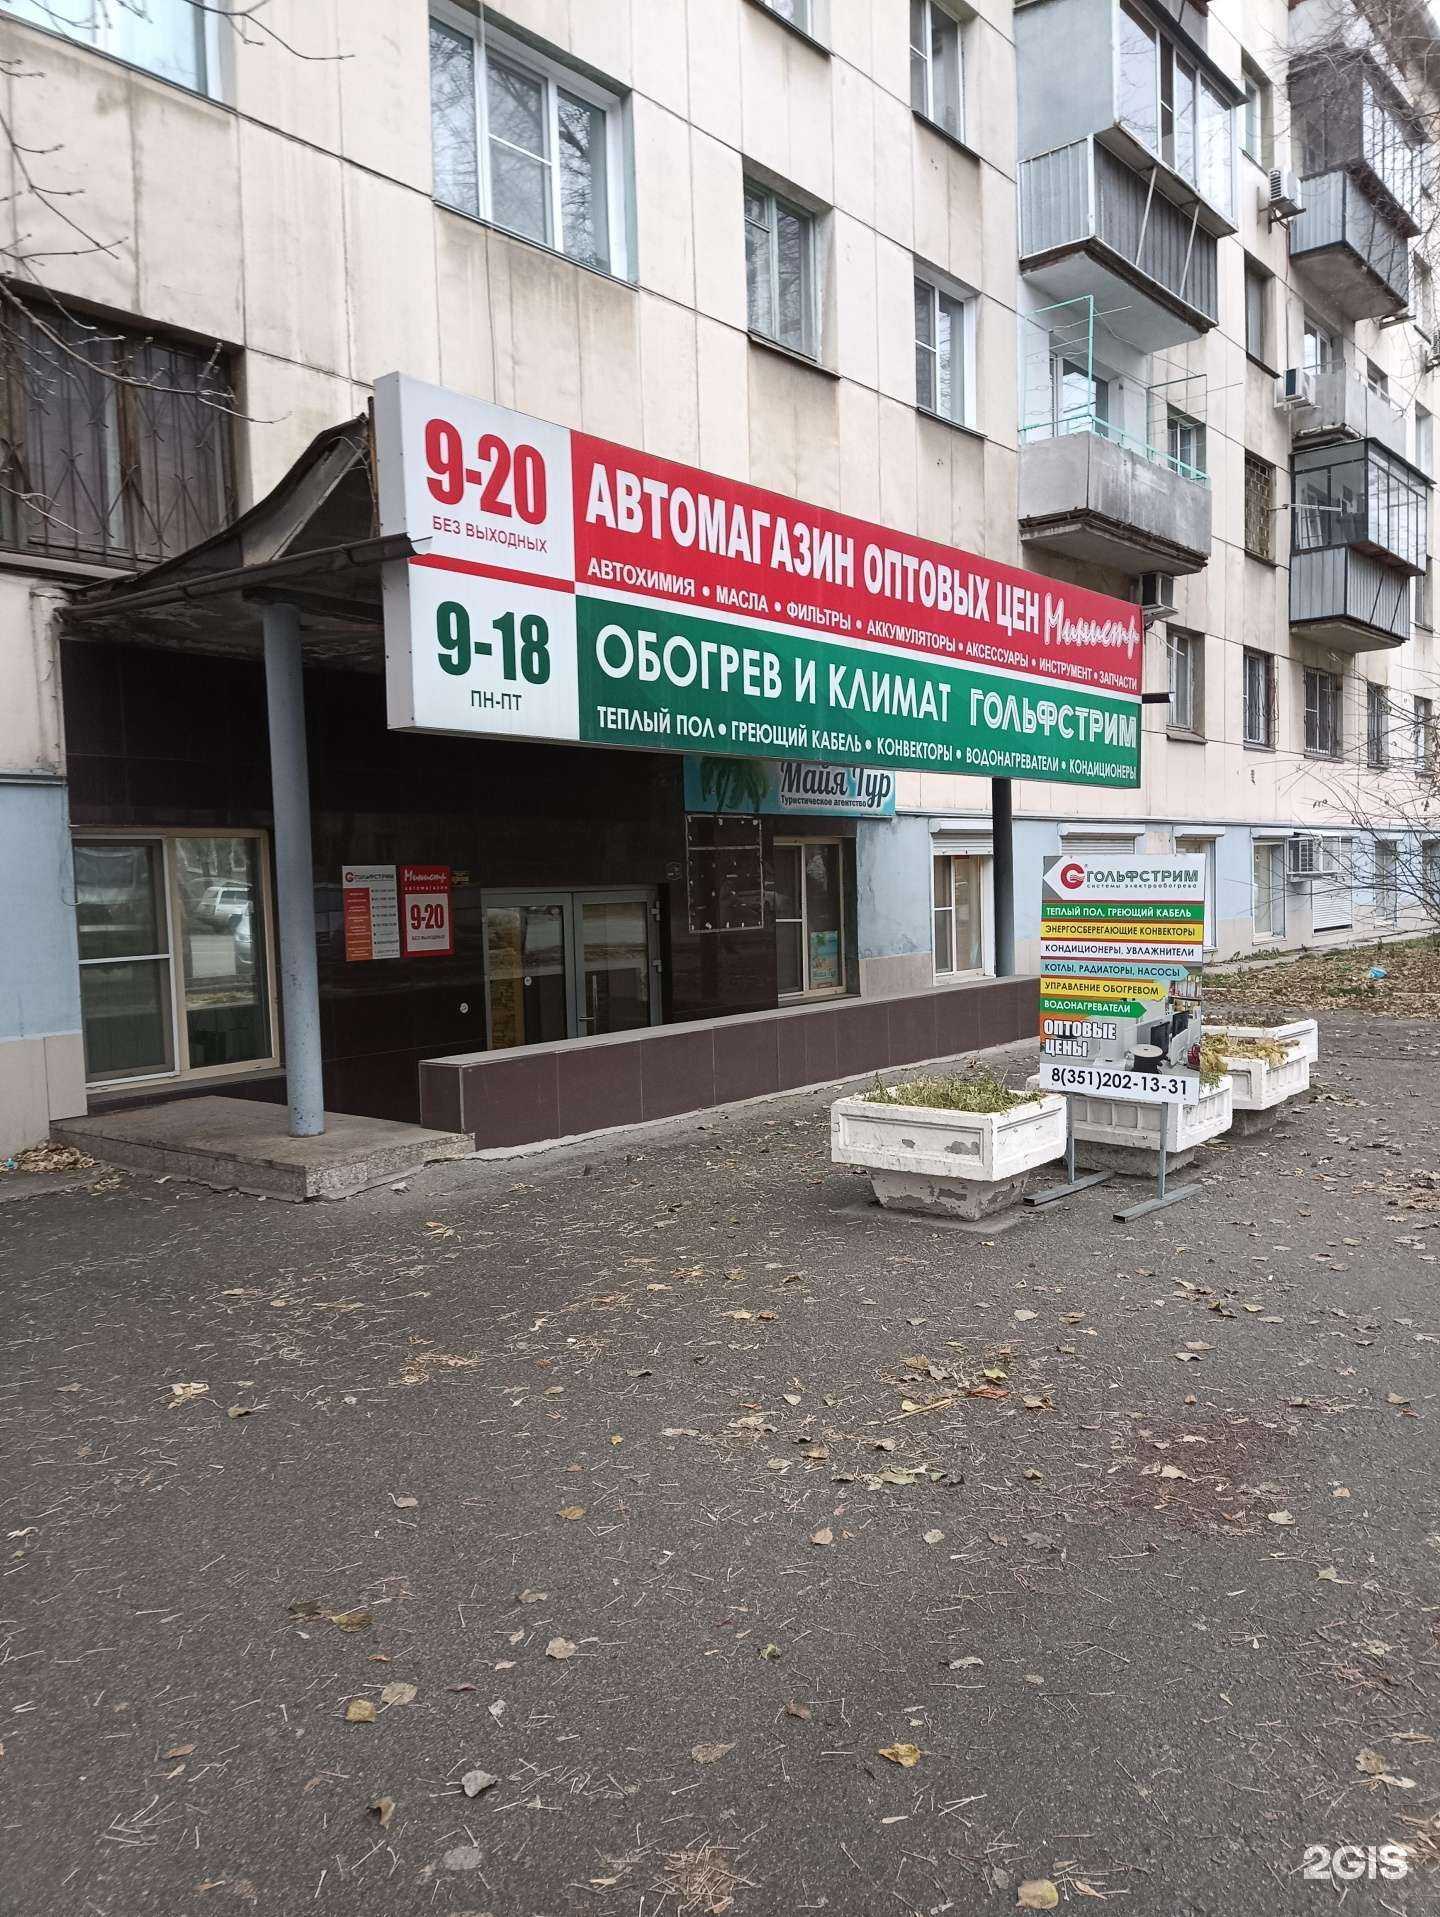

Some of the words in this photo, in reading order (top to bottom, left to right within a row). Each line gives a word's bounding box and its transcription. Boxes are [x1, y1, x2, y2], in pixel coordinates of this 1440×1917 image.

[425, 418, 547, 525] 9-20
[432, 515, 461, 535] БЕЗ
[466, 524, 548, 553] ВЫХОДНЫХ
[585, 463, 854, 587] АВТОМАГАЗИН
[863, 543, 990, 623] ОПТОВЫХ
[996, 581, 1039, 636] ЦЕН
[1044, 592, 1140, 660] Министр
[587, 557, 695, 597] АВТОХИМИЯ
[716, 585, 768, 612] МАСЛА
[787, 600, 852, 630] ФИЛЬТРЫ
[867, 619, 956, 653] АККУМУЛЯТОРЫ
[965, 643, 1029, 668] АКСЕССУАРЫ
[1040, 656, 1092, 680] ИНСТРУМЕНТ
[1099, 670, 1137, 690] ЗАПЧАСТИ
[436, 600, 551, 685] 9-18
[596, 624, 782, 699] ОБОГРЕВ
[795, 657, 816, 704] И
[829, 664, 951, 722] КЛИМАТ
[970, 688, 1137, 749] ГОЛЬФСТРИМ
[471, 690, 522, 711] ПН-ПТ
[597, 705, 671, 734] ТЕПЛЫЙ
[677, 715, 715, 738] ПОЛ
[731, 720, 807, 748] ГРЕЮЩИЙ
[812, 730, 862, 752] КАБЕЛЬ
[877, 737, 953, 761] КОНВЕКТОРЫ
[966, 747, 1059, 772] ВОДОНАГРЕВАТЕЛИ
[1069, 758, 1137, 781] КОНДИЦИОНЕРЫ
[781, 761, 848, 796] Майя
[852, 767, 891, 808] Тур
[781, 795, 832, 807] Туристическое
[1086, 870, 1198, 882] ГОЛЬФСТРИМ
[410, 904, 445, 930] 9-20
[1046, 906, 1081, 916] ТЕПЛЫЙ
[1083, 907, 1105, 918] ПОЛ,
[1108, 906, 1154, 918] ГРЕЮЩИЙ
[1156, 908, 1191, 917] КАБЕЛЬ
[1045, 925, 1138, 936] ЭНЕРГОСБЕРЕГАЮЩИЕ
[1139, 927, 1195, 936] КОНВЕКТОРЫ
[1126, 947, 1194, 957] УВЛАЖНИТЕЛИ
[1044, 963, 1076, 973] КОТЛЫ,
[1079, 965, 1135, 976] РАДИАТОРЫ,
[1138, 967, 1180, 977] НАСОСЫ
[1045, 981, 1101, 992] УПРАВЛЕНИЕ
[1103, 984, 1159, 995] ОБОГРЕВОМ
[1044, 1000, 1131, 1013] ВОДОНАГРЕВАТЕЛИ
[1043, 1019, 1117, 1040] ОПТОВЫЕ
[1044, 1038, 1088, 1058] ЦЕНЫ
[1051, 1067, 1187, 1096] 8(351)202-13-31
